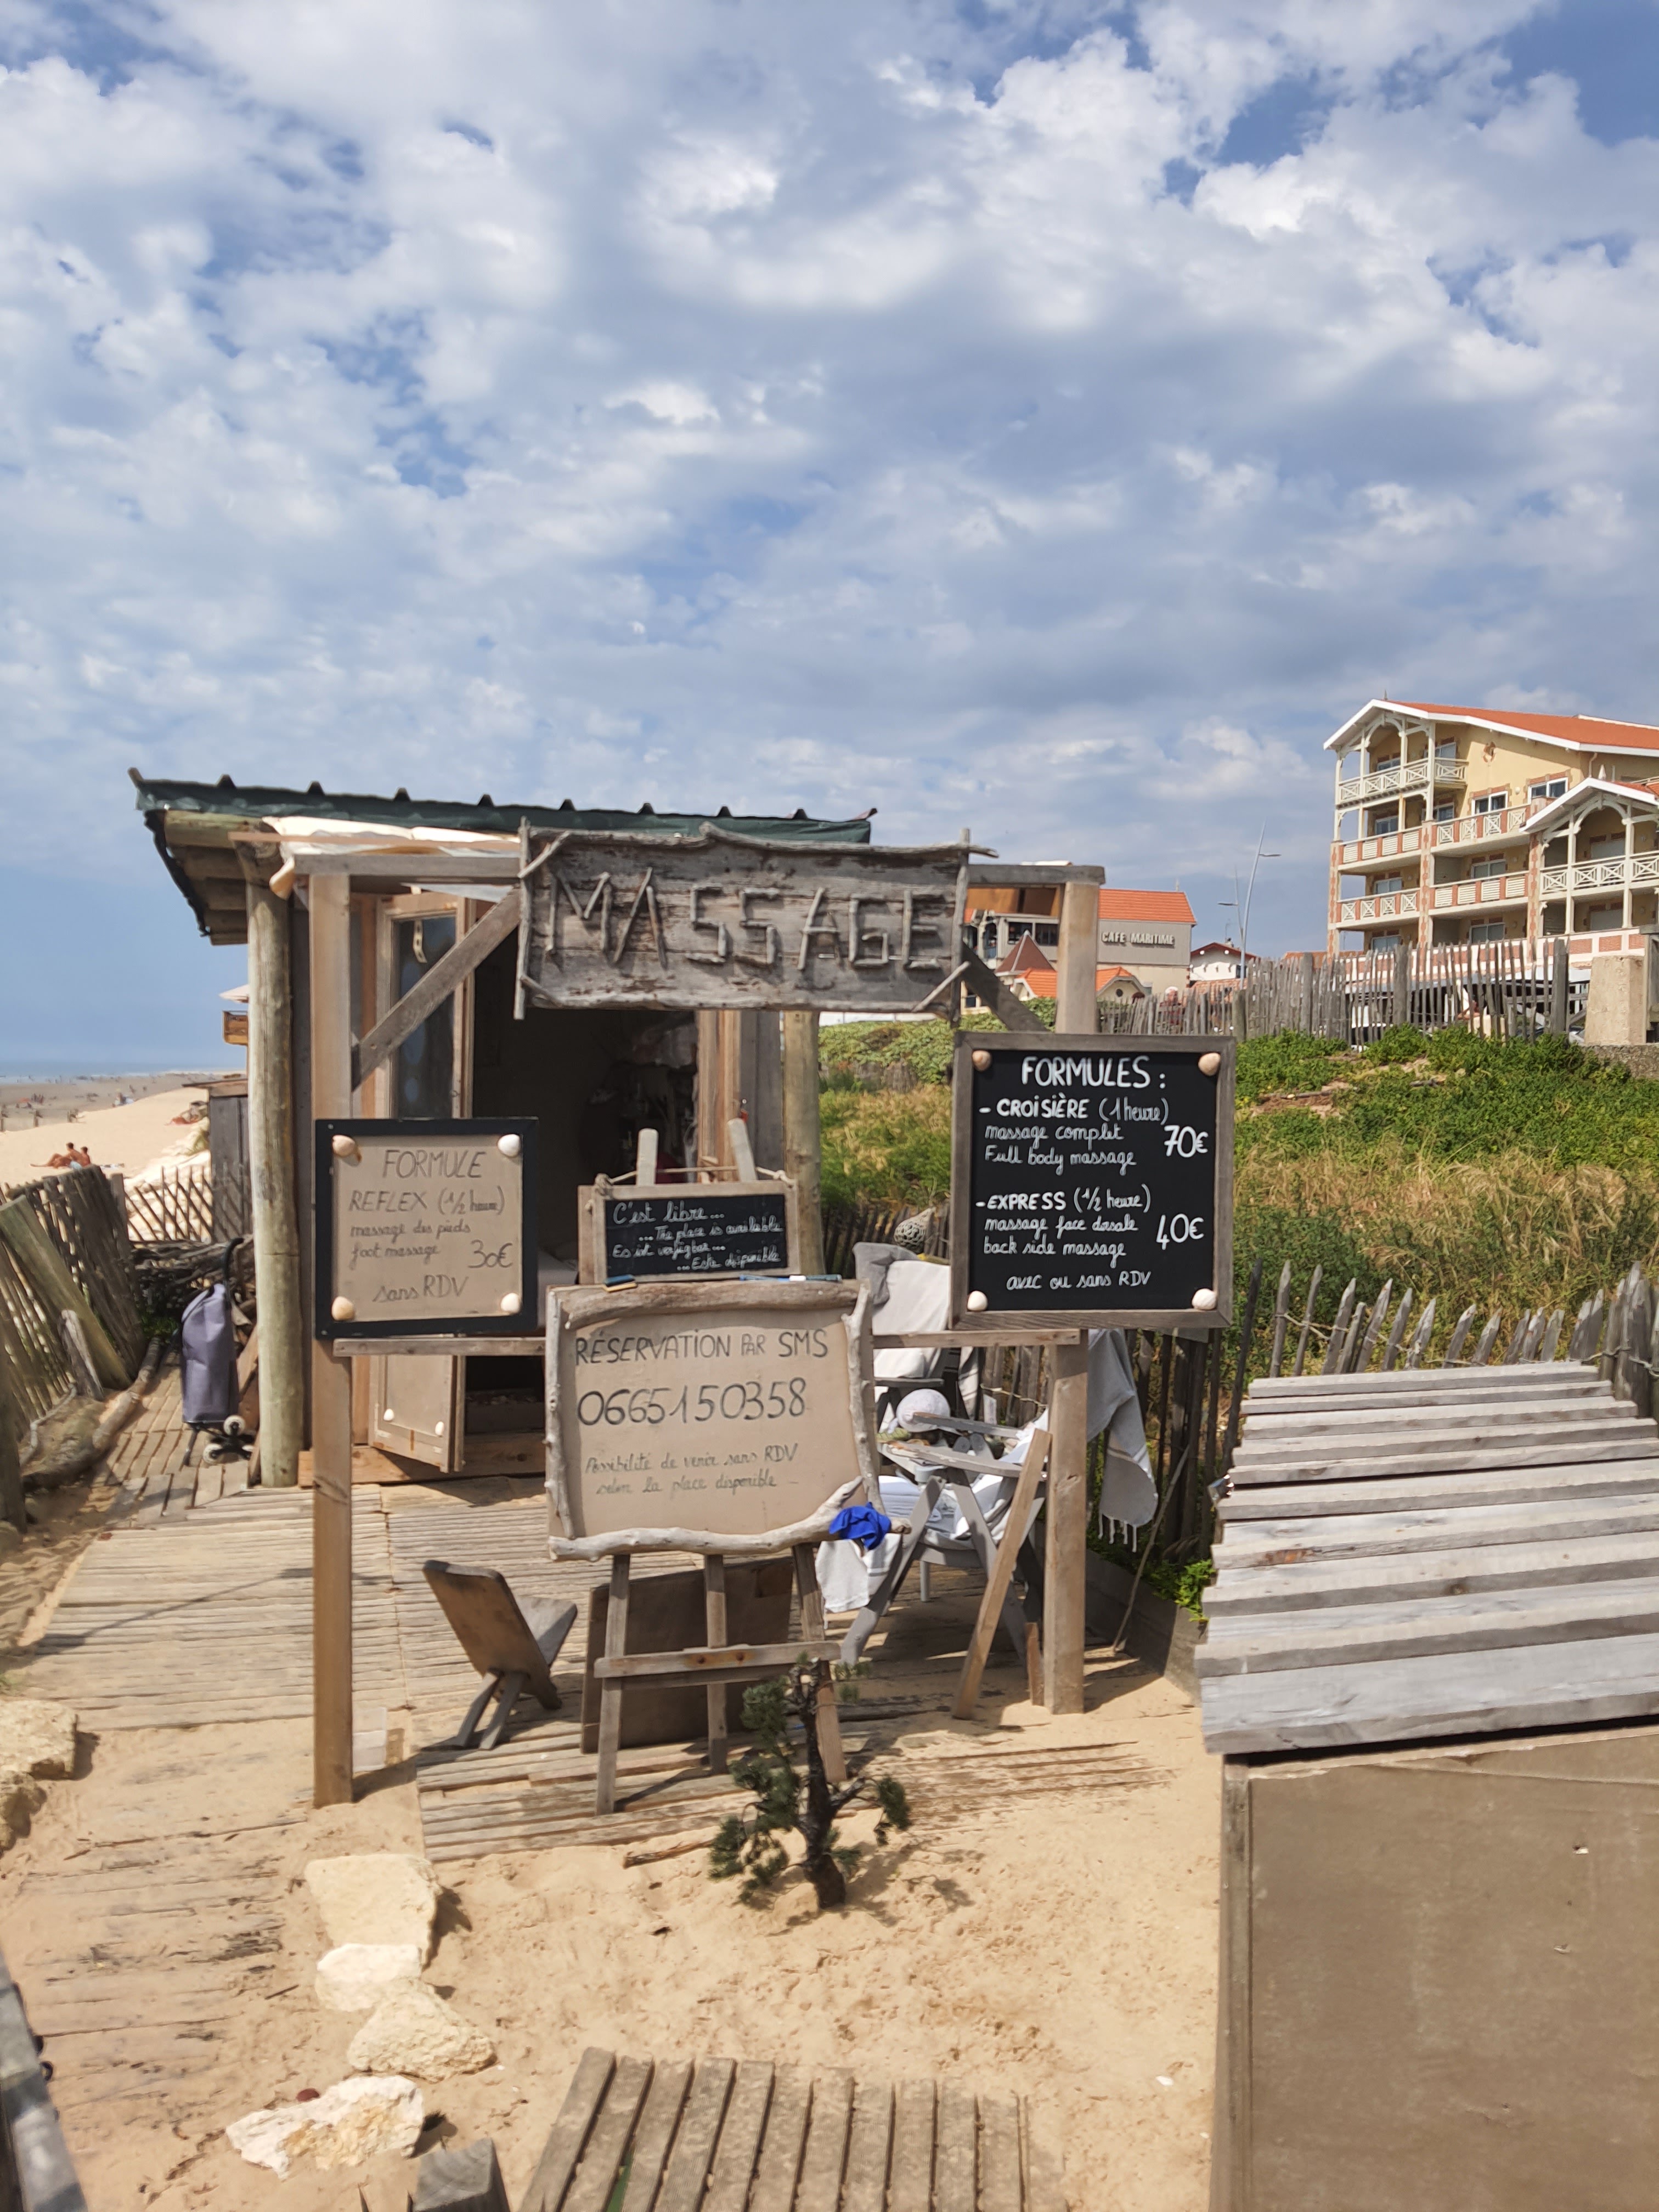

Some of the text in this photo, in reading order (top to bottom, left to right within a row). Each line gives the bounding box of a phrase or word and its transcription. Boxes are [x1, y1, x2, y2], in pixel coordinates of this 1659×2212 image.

[546, 866, 941, 970] MASSAGE
[1102, 932, 1175, 945] CAFE MARITIME
[1022, 1056, 1150, 1088] FORMULES
[985, 1122, 1124, 1150] massage complet
[1164, 1125, 1209, 1158] 70€
[382, 1149, 487, 1179] FORMULE
[985, 1144, 1137, 1176] Full body massage
[348, 1189, 428, 1213] REFLEX
[613, 1201, 657, 1225] C'est
[412, 1219, 433, 1234] des
[436, 1218, 471, 1240] pieds
[708, 1221, 724, 1236] is
[984, 1213, 1139, 1240] massage face dorsale
[1156, 1214, 1205, 1250] 40€
[348, 1242, 383, 1271] foot
[467, 1239, 514, 1269] 30€
[612, 1244, 632, 1259] Es
[633, 1243, 655, 1259] ist
[984, 1233, 1127, 1268] back side massage
[371, 1274, 471, 1304] sans RDV
[1006, 1269, 1152, 1291] avec ou sans RDV
[740, 1333, 766, 1356] PAR
[777, 1329, 829, 1358] SMS
[577, 1376, 806, 1426] 0665150358
[661, 1452, 678, 1470] de
[684, 1452, 720, 1468] venir
[723, 1453, 758, 1466] sans
[764, 1442, 799, 1463] RDV
[669, 1475, 708, 1498] place
